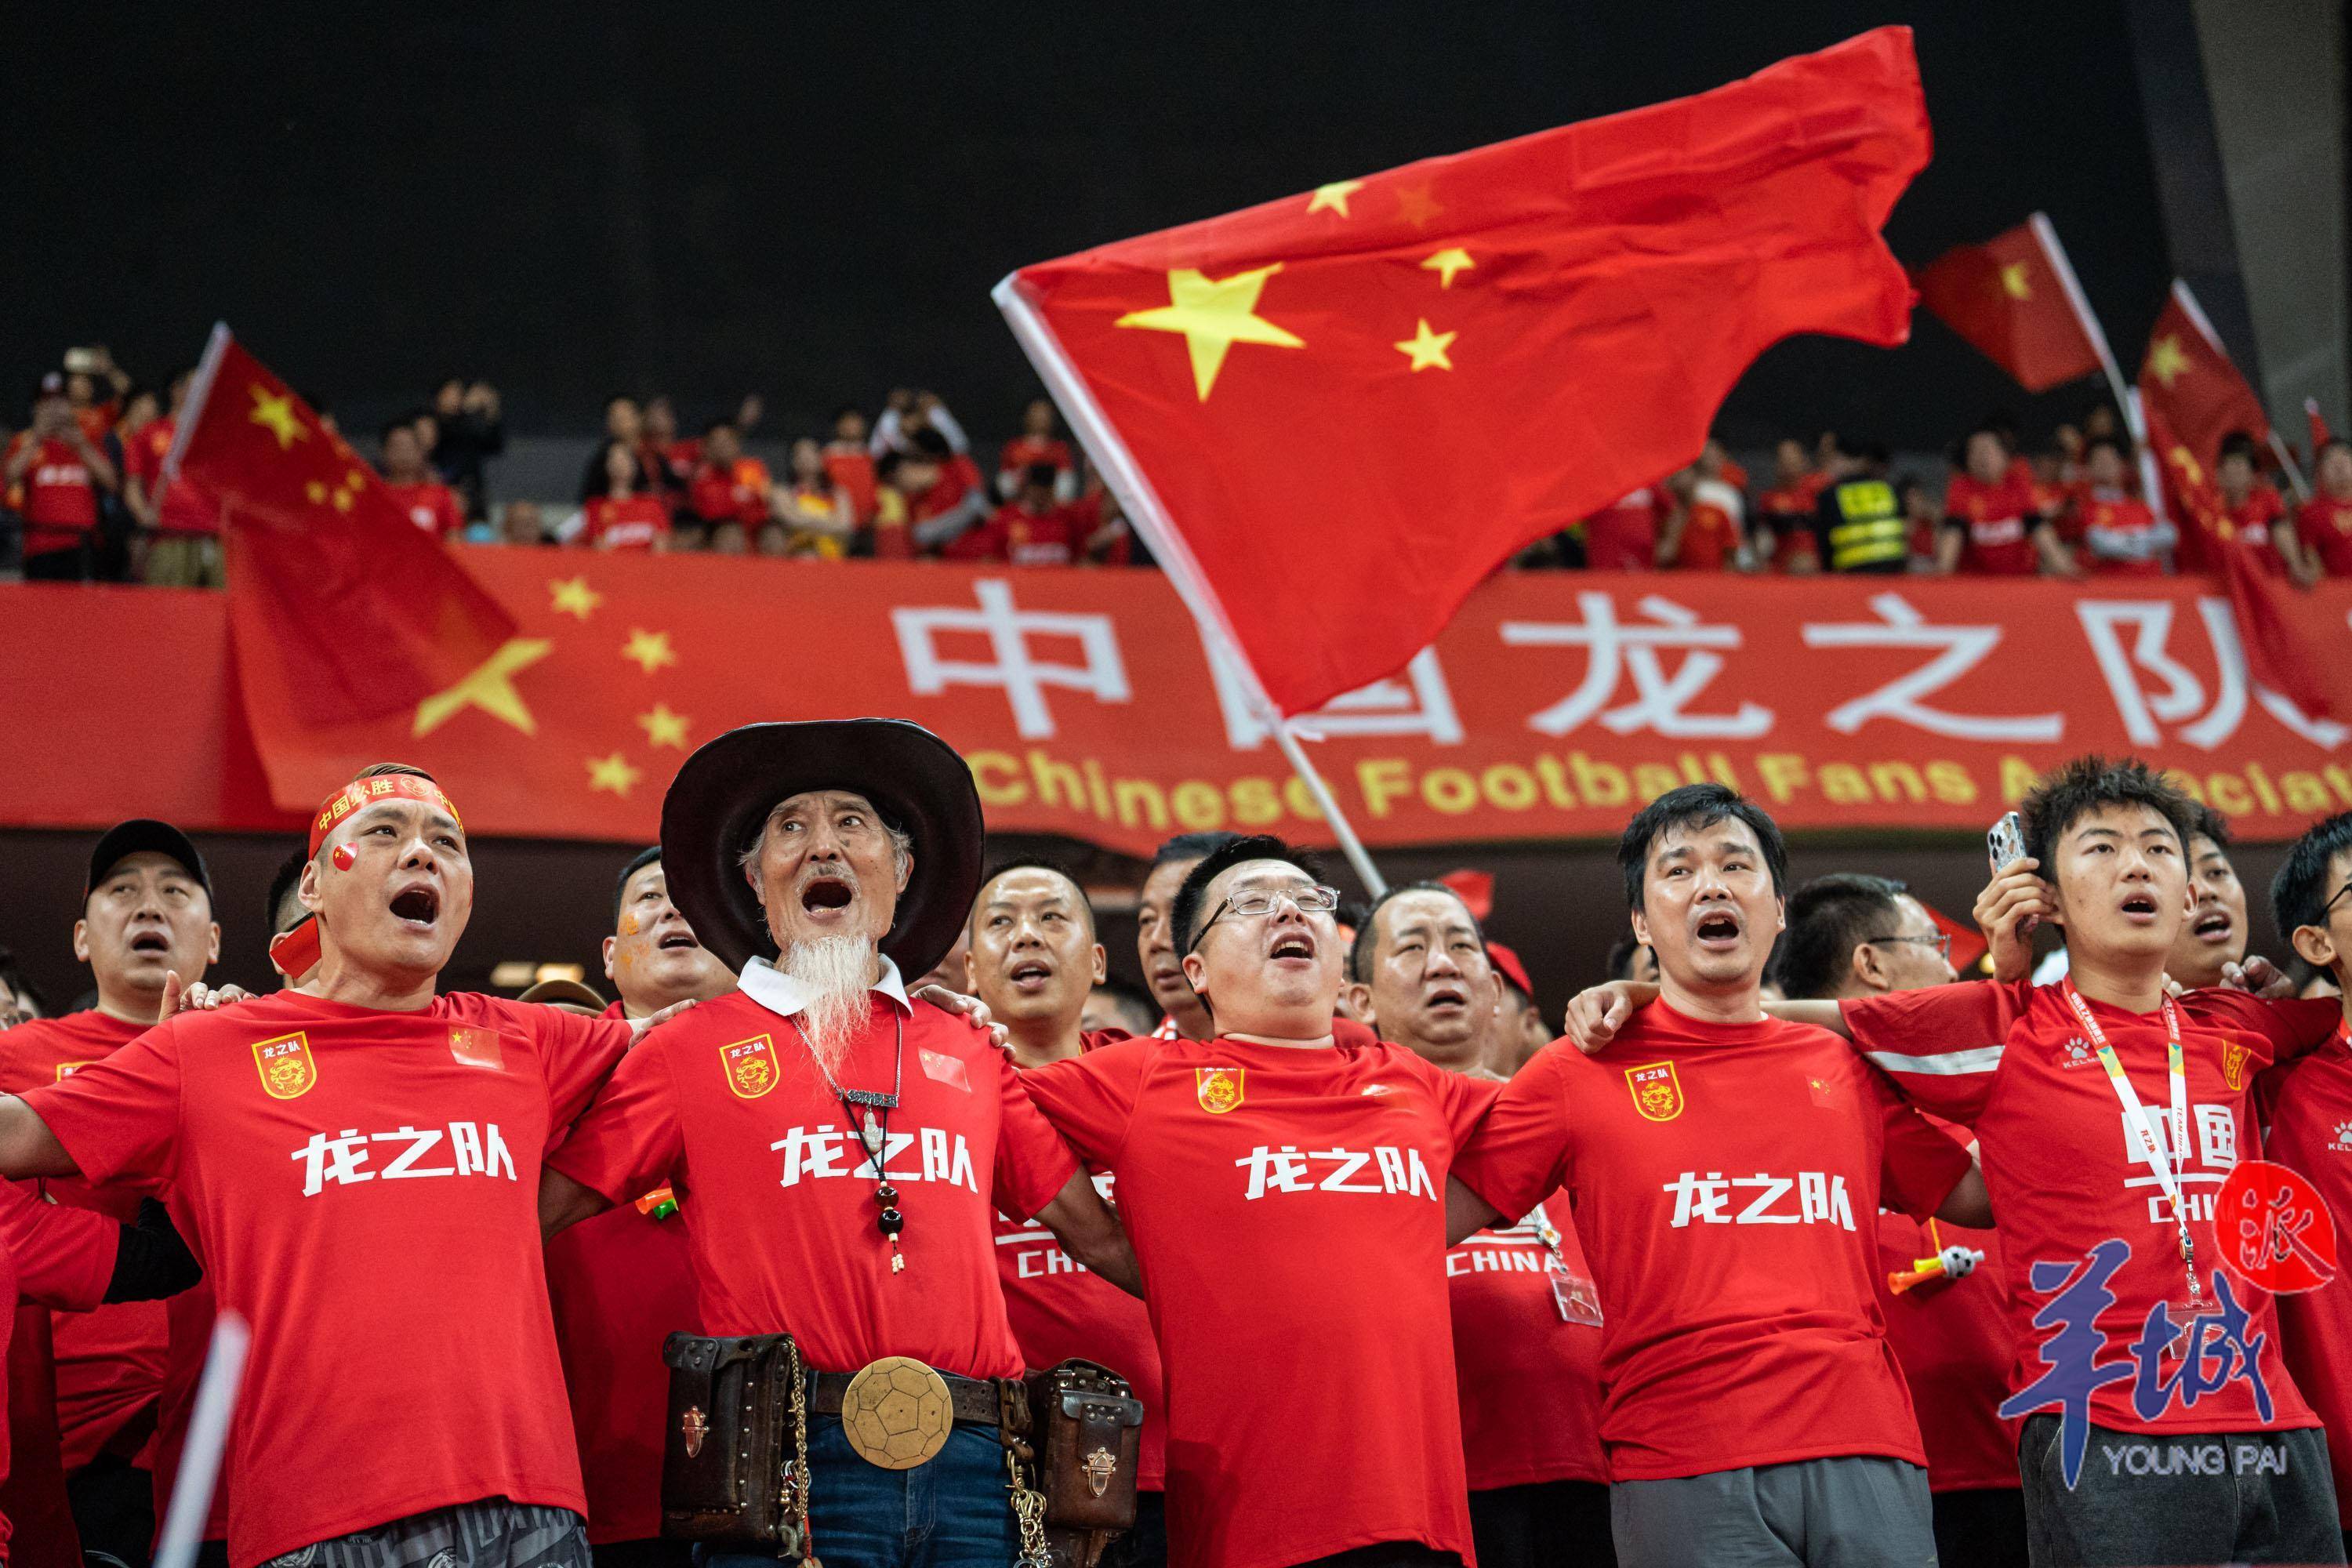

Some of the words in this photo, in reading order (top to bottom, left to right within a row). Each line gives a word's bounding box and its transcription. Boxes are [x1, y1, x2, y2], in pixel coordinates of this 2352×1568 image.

[319, 779, 395, 830] 中国必胜
[964, 750, 1334, 832] Chinese
[1356, 751, 1740, 819] Football
[1756, 753, 1979, 807] Fans
[263, 1040, 301, 1059] 龙之队
[730, 1041, 766, 1058] 龙之队
[291, 1122, 517, 1197] 龙之队
[770, 1124, 978, 1194] 龙之队
[1235, 1145, 1437, 1202] 龙之队
[1663, 1171, 1857, 1232] 龙之队
[1446, 1250, 1562, 1278] CHINA
